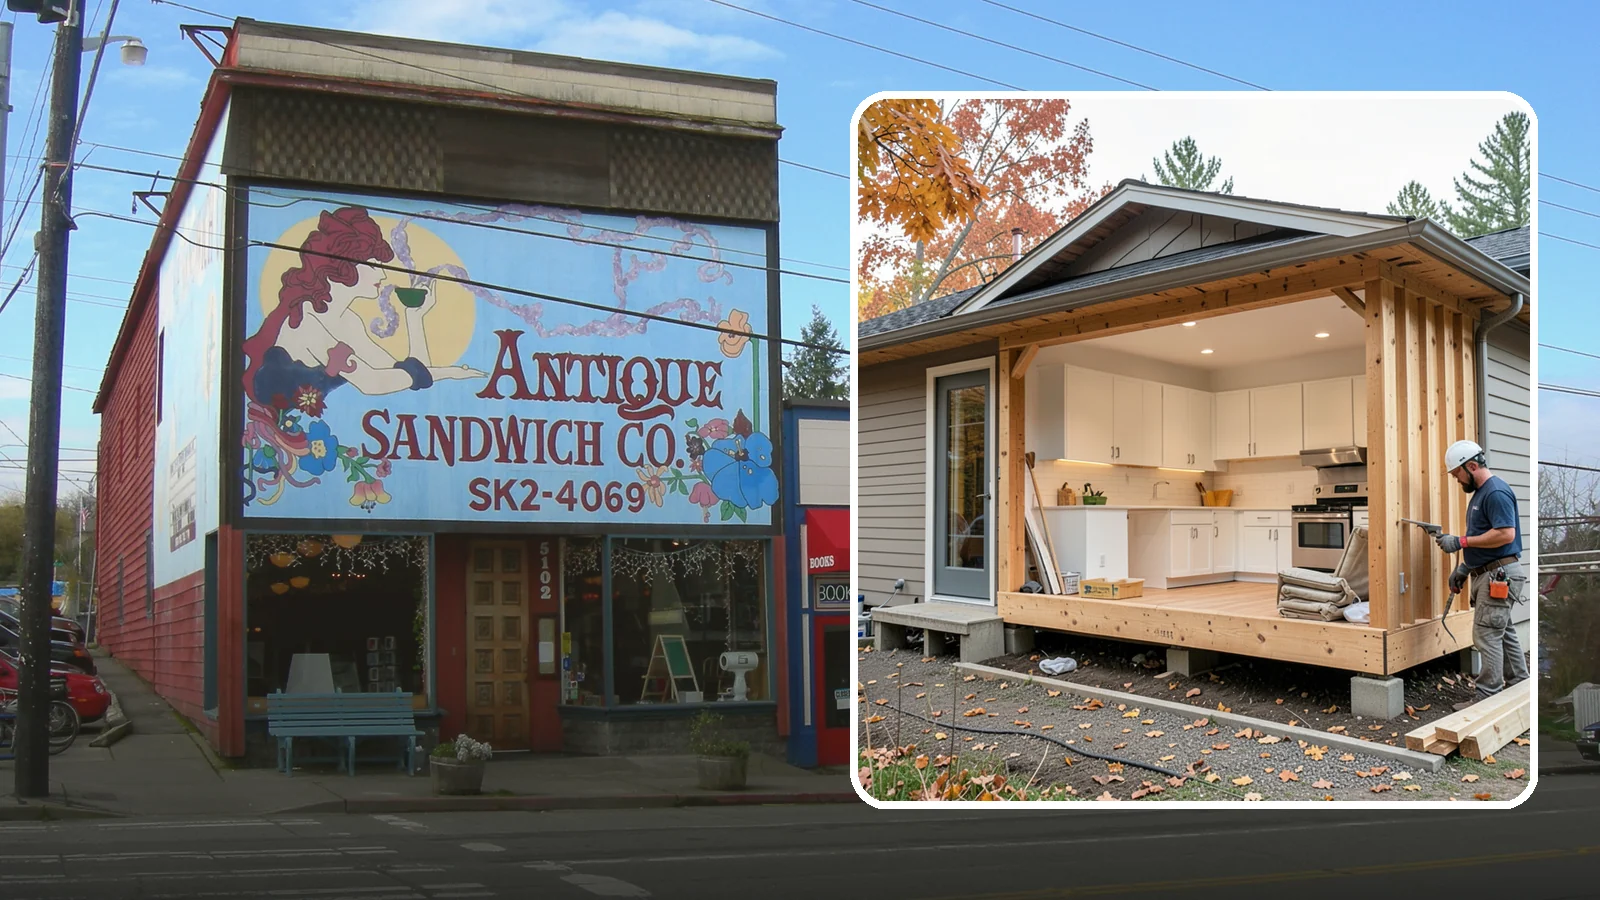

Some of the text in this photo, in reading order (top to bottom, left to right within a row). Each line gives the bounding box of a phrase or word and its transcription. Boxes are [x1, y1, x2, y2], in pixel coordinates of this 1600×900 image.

[477, 329, 723, 420] ANTIQUE
[362, 409, 686, 468] SANDWICH CO.
[469, 477, 644, 513] SK2-4069
[540, 542, 551, 599] 5102
[809, 556, 834, 569] BOOKS
